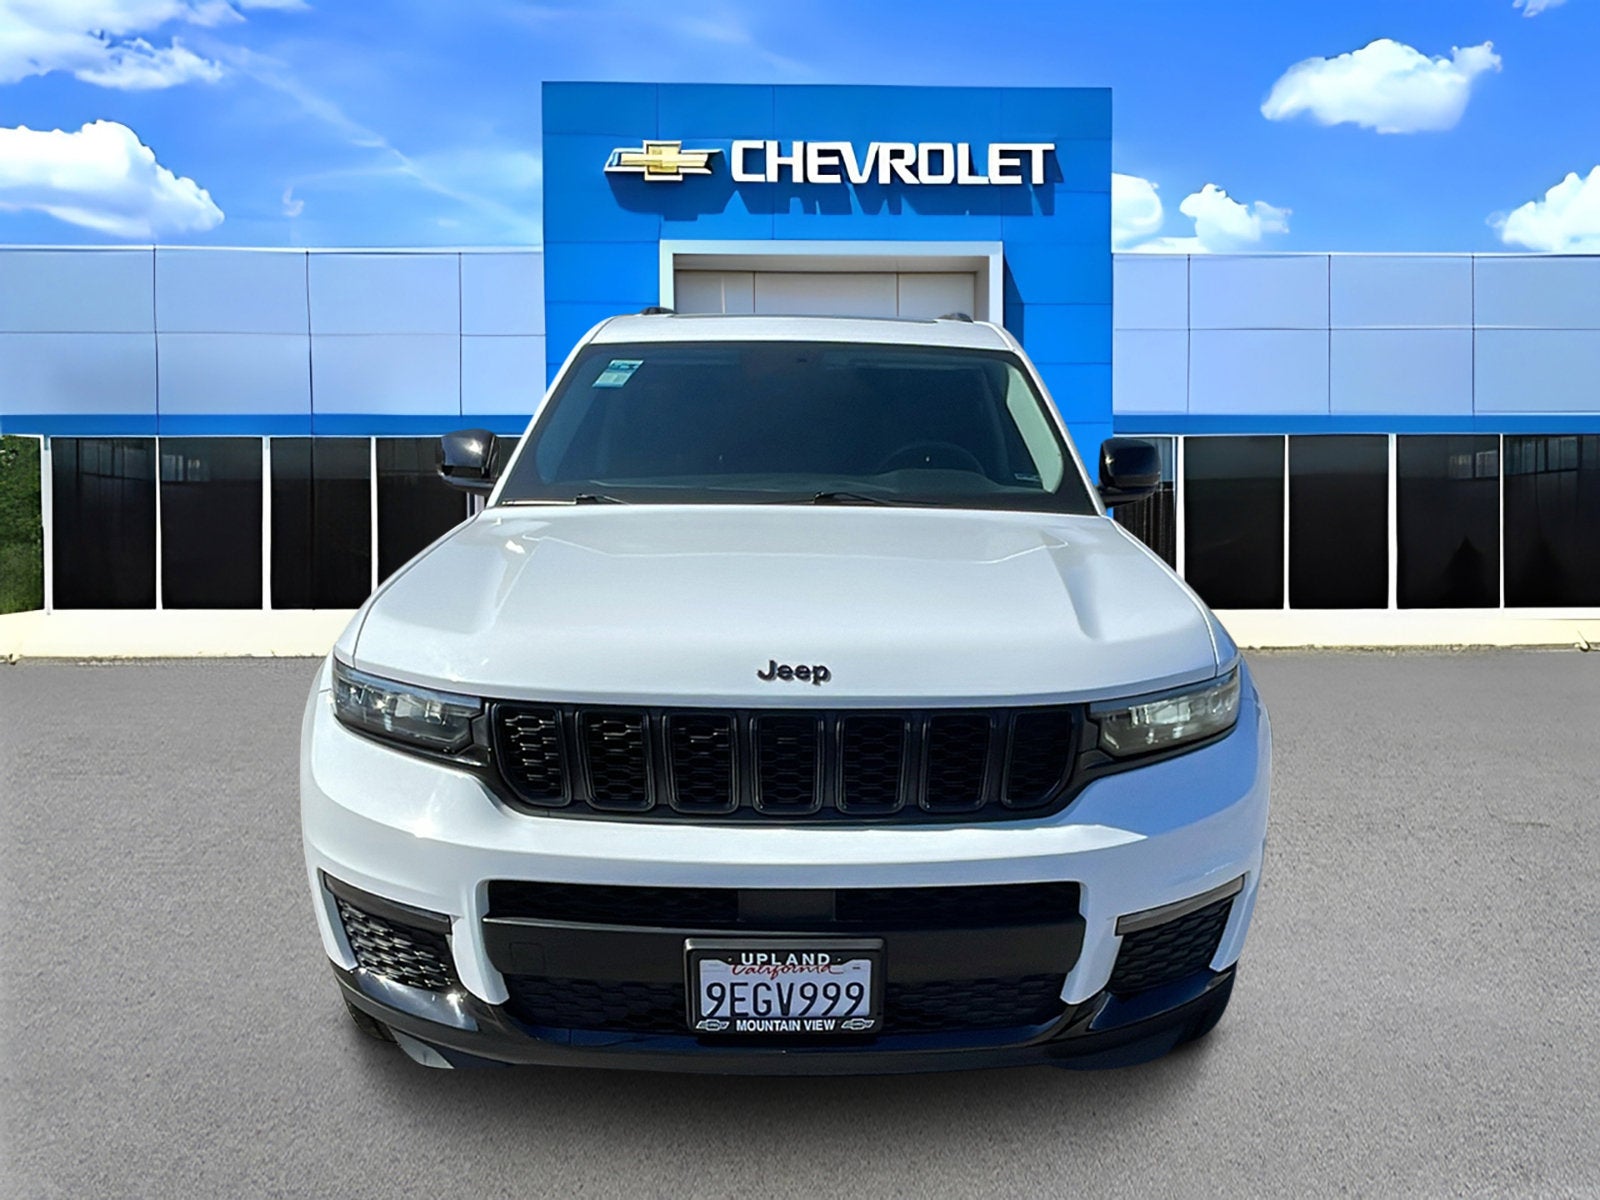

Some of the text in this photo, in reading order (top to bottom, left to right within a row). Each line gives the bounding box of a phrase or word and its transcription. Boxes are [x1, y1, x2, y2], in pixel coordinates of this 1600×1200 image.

[731, 140, 1055, 185] CHEVROLET
[757, 660, 831, 686] Jeep
[741, 953, 831, 966] UPLAND
[706, 982, 864, 1017] 9EGV999
[736, 1019, 800, 1031] MOUNTAIN
[804, 1019, 835, 1031] VIEW
